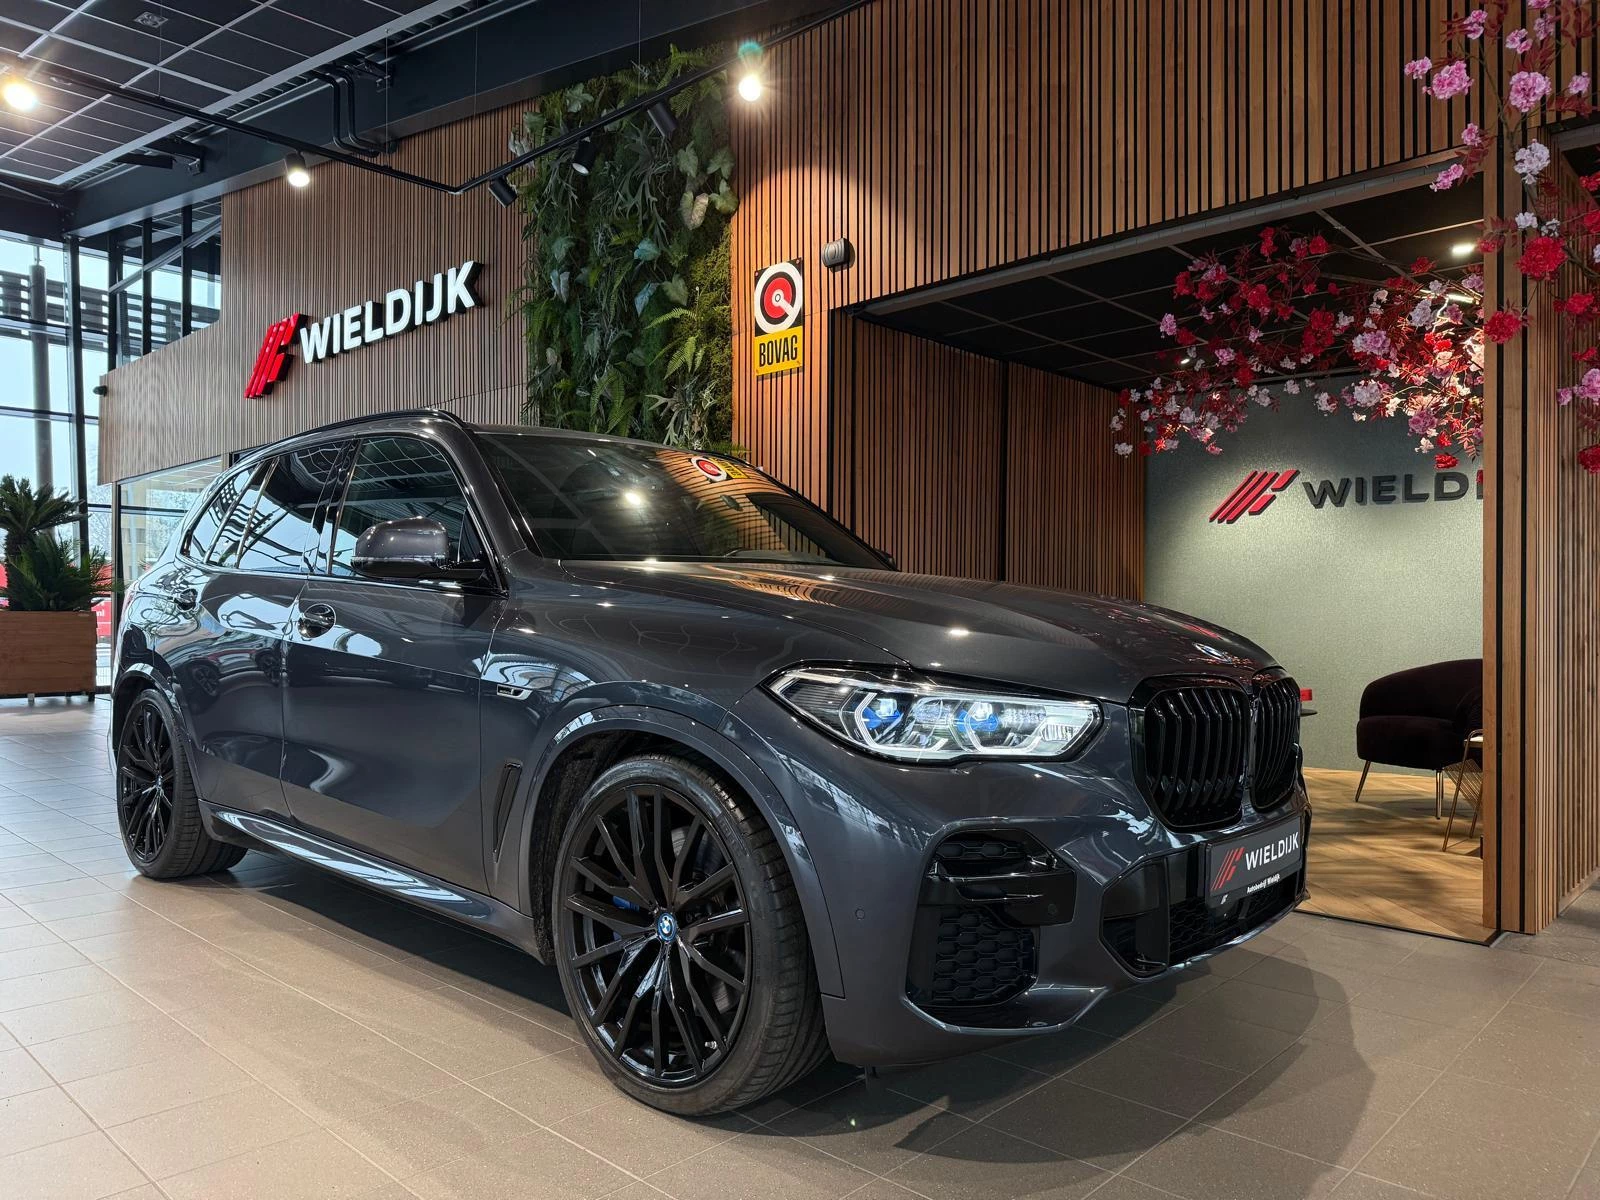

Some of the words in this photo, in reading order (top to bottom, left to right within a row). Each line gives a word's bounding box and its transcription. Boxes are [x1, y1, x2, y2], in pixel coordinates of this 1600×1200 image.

[300, 260, 476, 364] WIELDIJK
[759, 334, 798, 367] BOVAG
[1245, 831, 1299, 870] WIELDIJK
